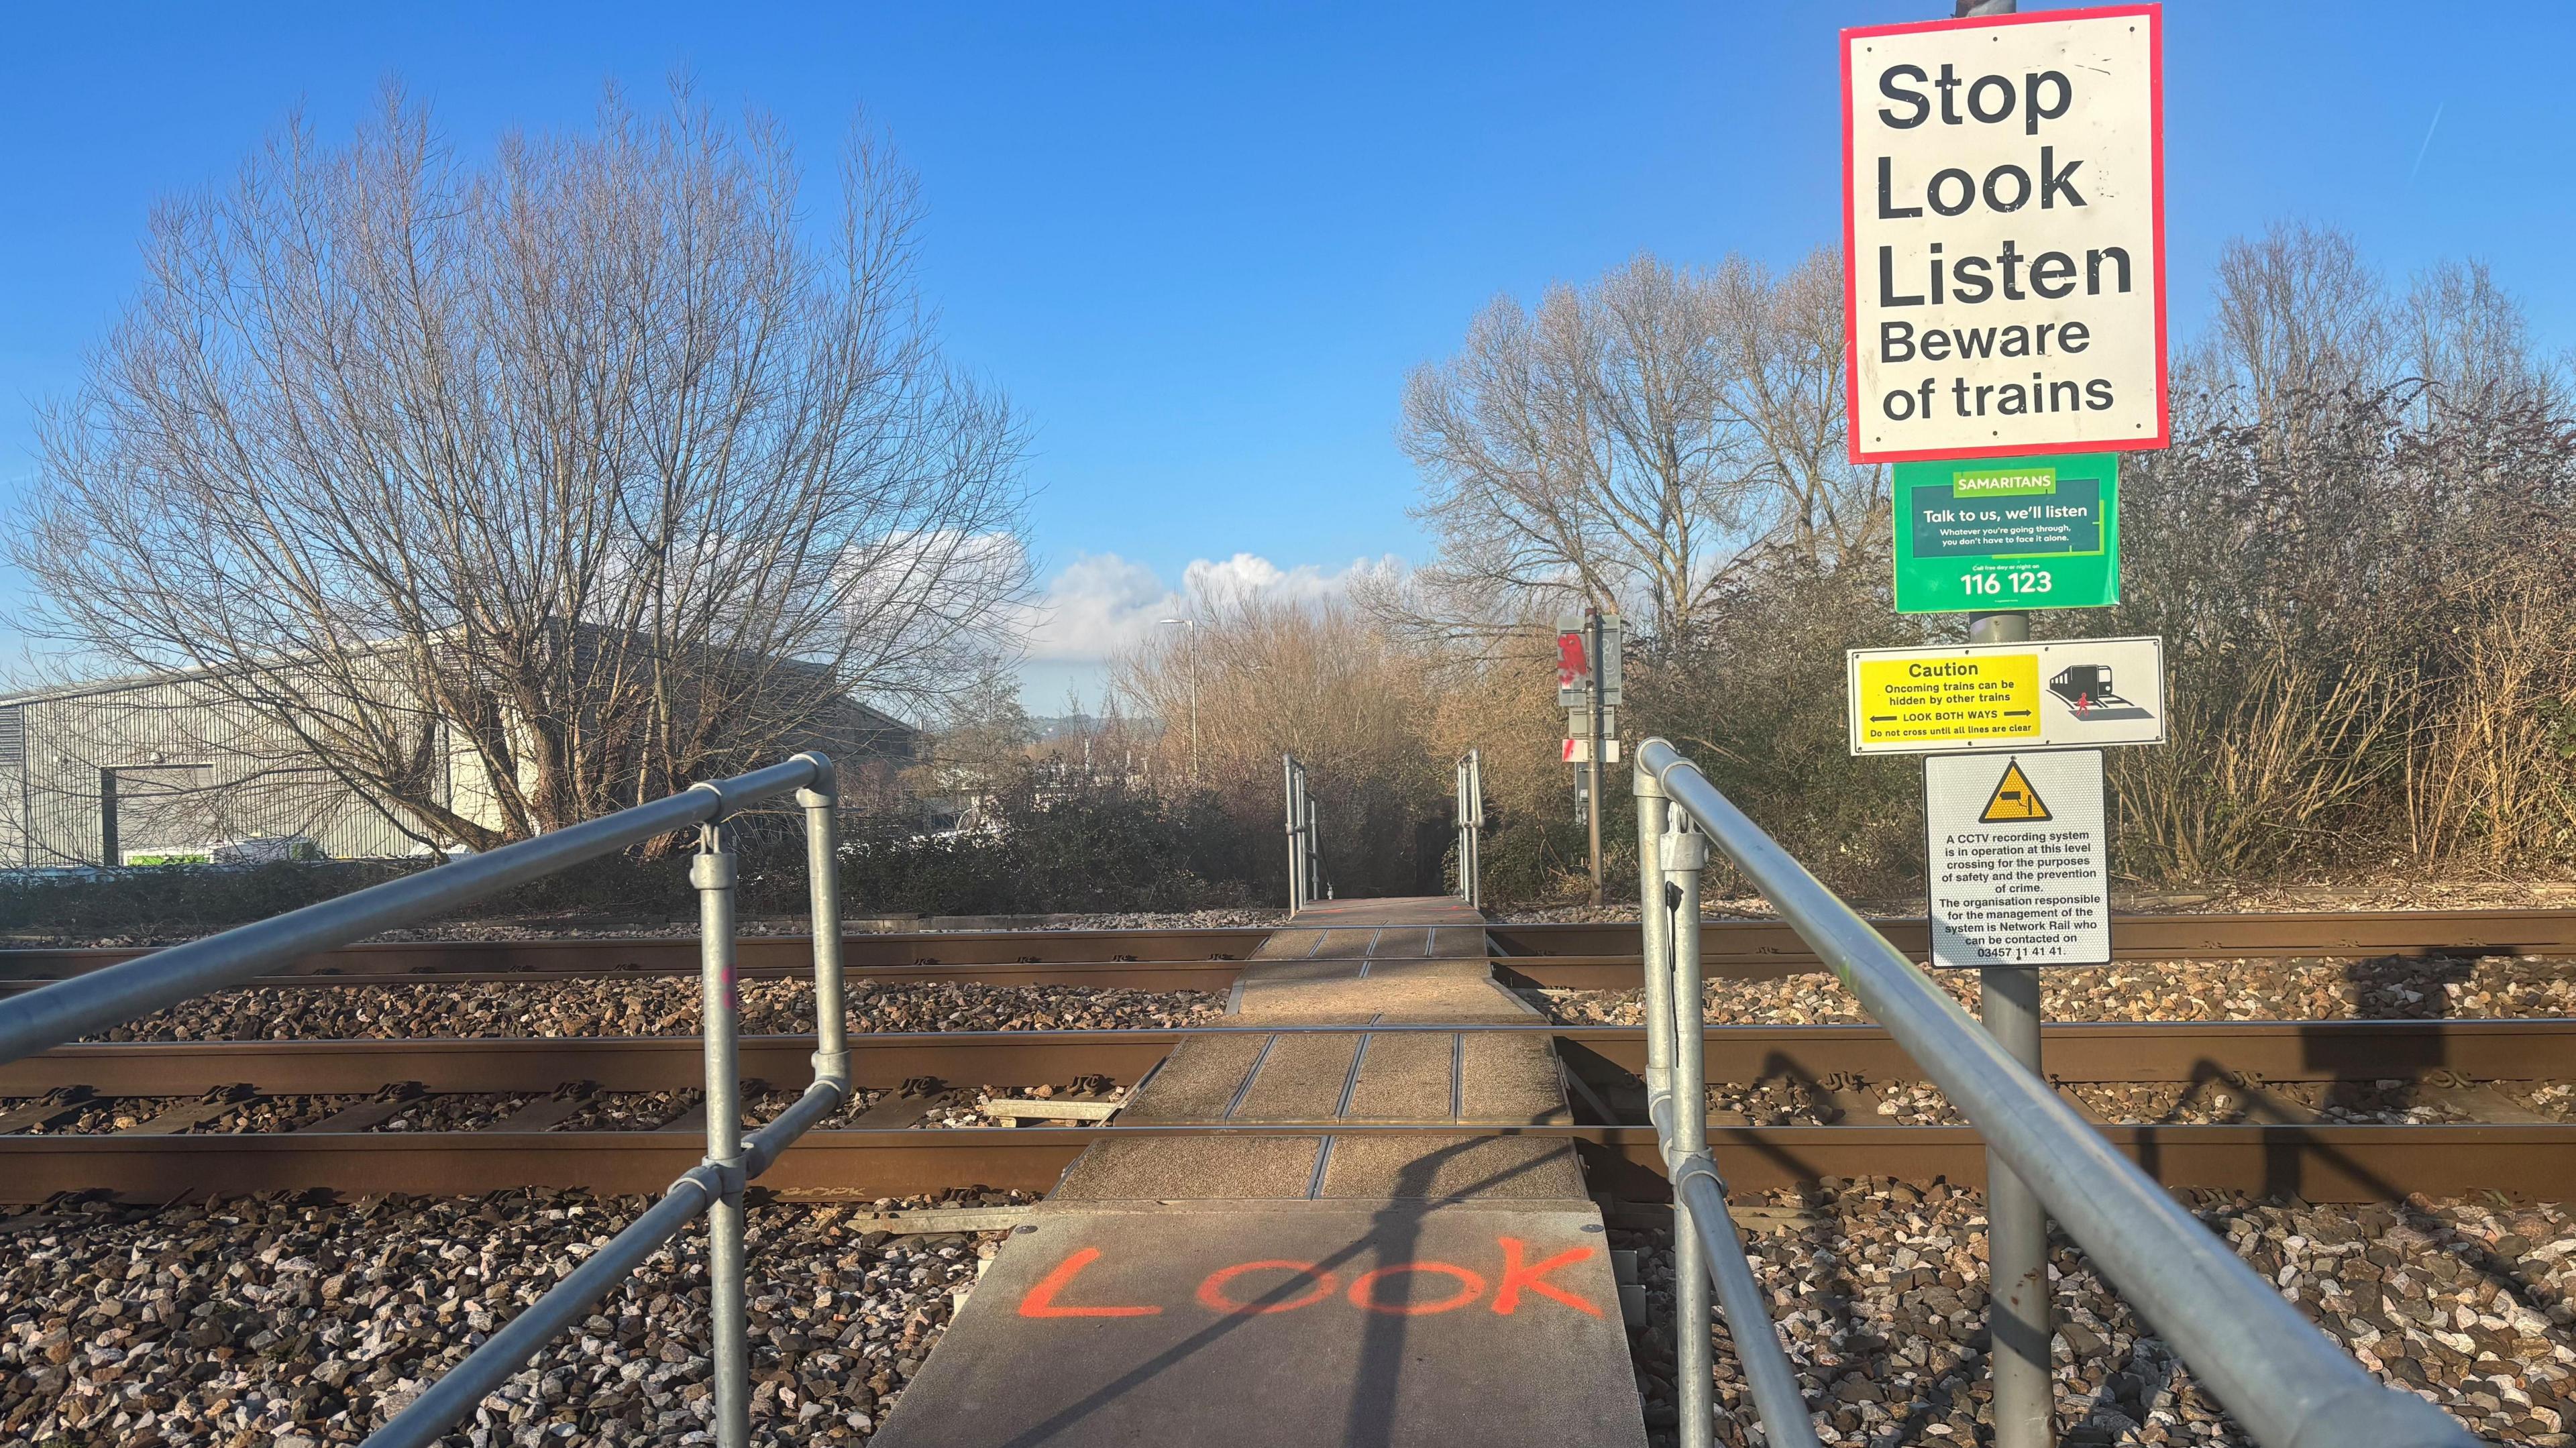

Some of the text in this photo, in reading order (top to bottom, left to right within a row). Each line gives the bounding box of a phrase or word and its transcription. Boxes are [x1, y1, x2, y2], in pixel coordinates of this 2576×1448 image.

[1878, 64, 2072, 135] Stop
[1878, 146, 2088, 219] Look
[1880, 240, 2131, 307] Listen
[1881, 321, 2090, 363] Beware
[1883, 372, 2113, 421] of trains
[1959, 476, 2051, 490] SAMARITANS
[1923, 506, 2087, 522] Talk to us, we'll listen
[1983, 527, 2008, 535] you're
[2010, 526, 2033, 535] going
[2036, 524, 2071, 533] through,
[1961, 571, 2051, 594] 116 123
[1909, 663, 1978, 677] Caution
[1885, 683, 1939, 693] Oncoming
[1943, 682, 1974, 691] trains
[2002, 680, 2014, 688] be
[1890, 693, 2010, 706] hidden by other trains
[1904, 710, 1997, 721] LOOK BOTH WAYS
[1947, 832, 2089, 844] A CCTV recording system
[1945, 843, 2090, 858] is in operation at this level
[1947, 858, 2090, 870] crossing for the purposes
[1942, 869, 2096, 883] of safety and the prevention
[1995, 884, 2043, 893] of crime.
[1939, 895, 2100, 908] The organisation responsible
[1948, 907, 2092, 920] for the management of the
[1945, 920, 2096, 934] system is Network Rail who
[1966, 937, 1984, 945] can
[1989, 936, 2002, 944] be
[2005, 934, 2059, 944] contacted
[1978, 946, 2065, 957] 03457 11 41 41.
[1018, 1237, 1605, 1319] LOOK
